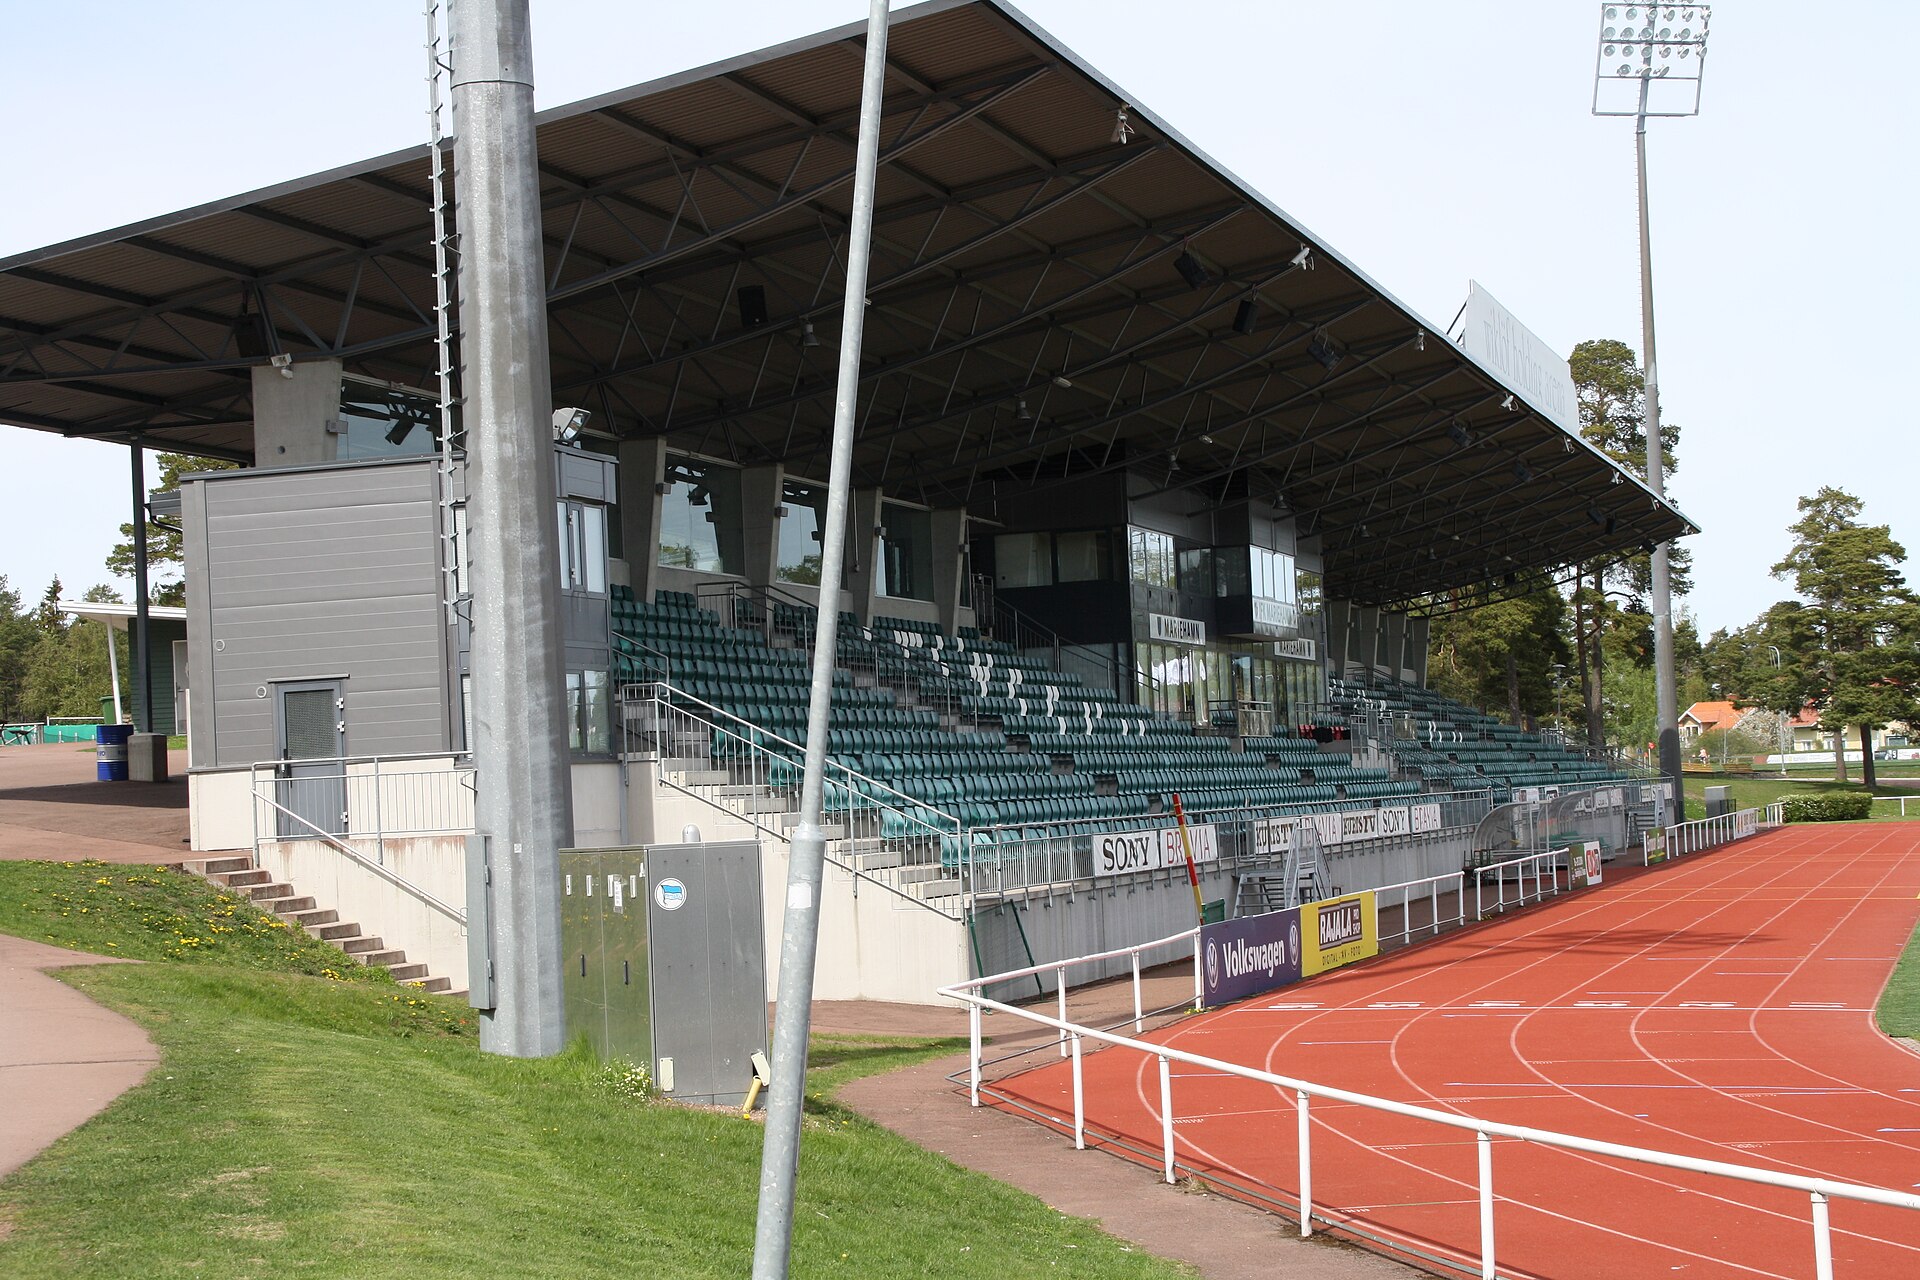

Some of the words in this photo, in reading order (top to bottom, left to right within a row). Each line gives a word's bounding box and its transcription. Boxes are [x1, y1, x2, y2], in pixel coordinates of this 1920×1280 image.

[1164, 616, 1201, 642] MARIEHAMN
[1383, 809, 1405, 834] SONY
[1102, 836, 1150, 872] SONY
[1166, 827, 1211, 865] BRVIA
[1320, 907, 1352, 945] RAJALA
[1222, 937, 1285, 978] Volkswagen
